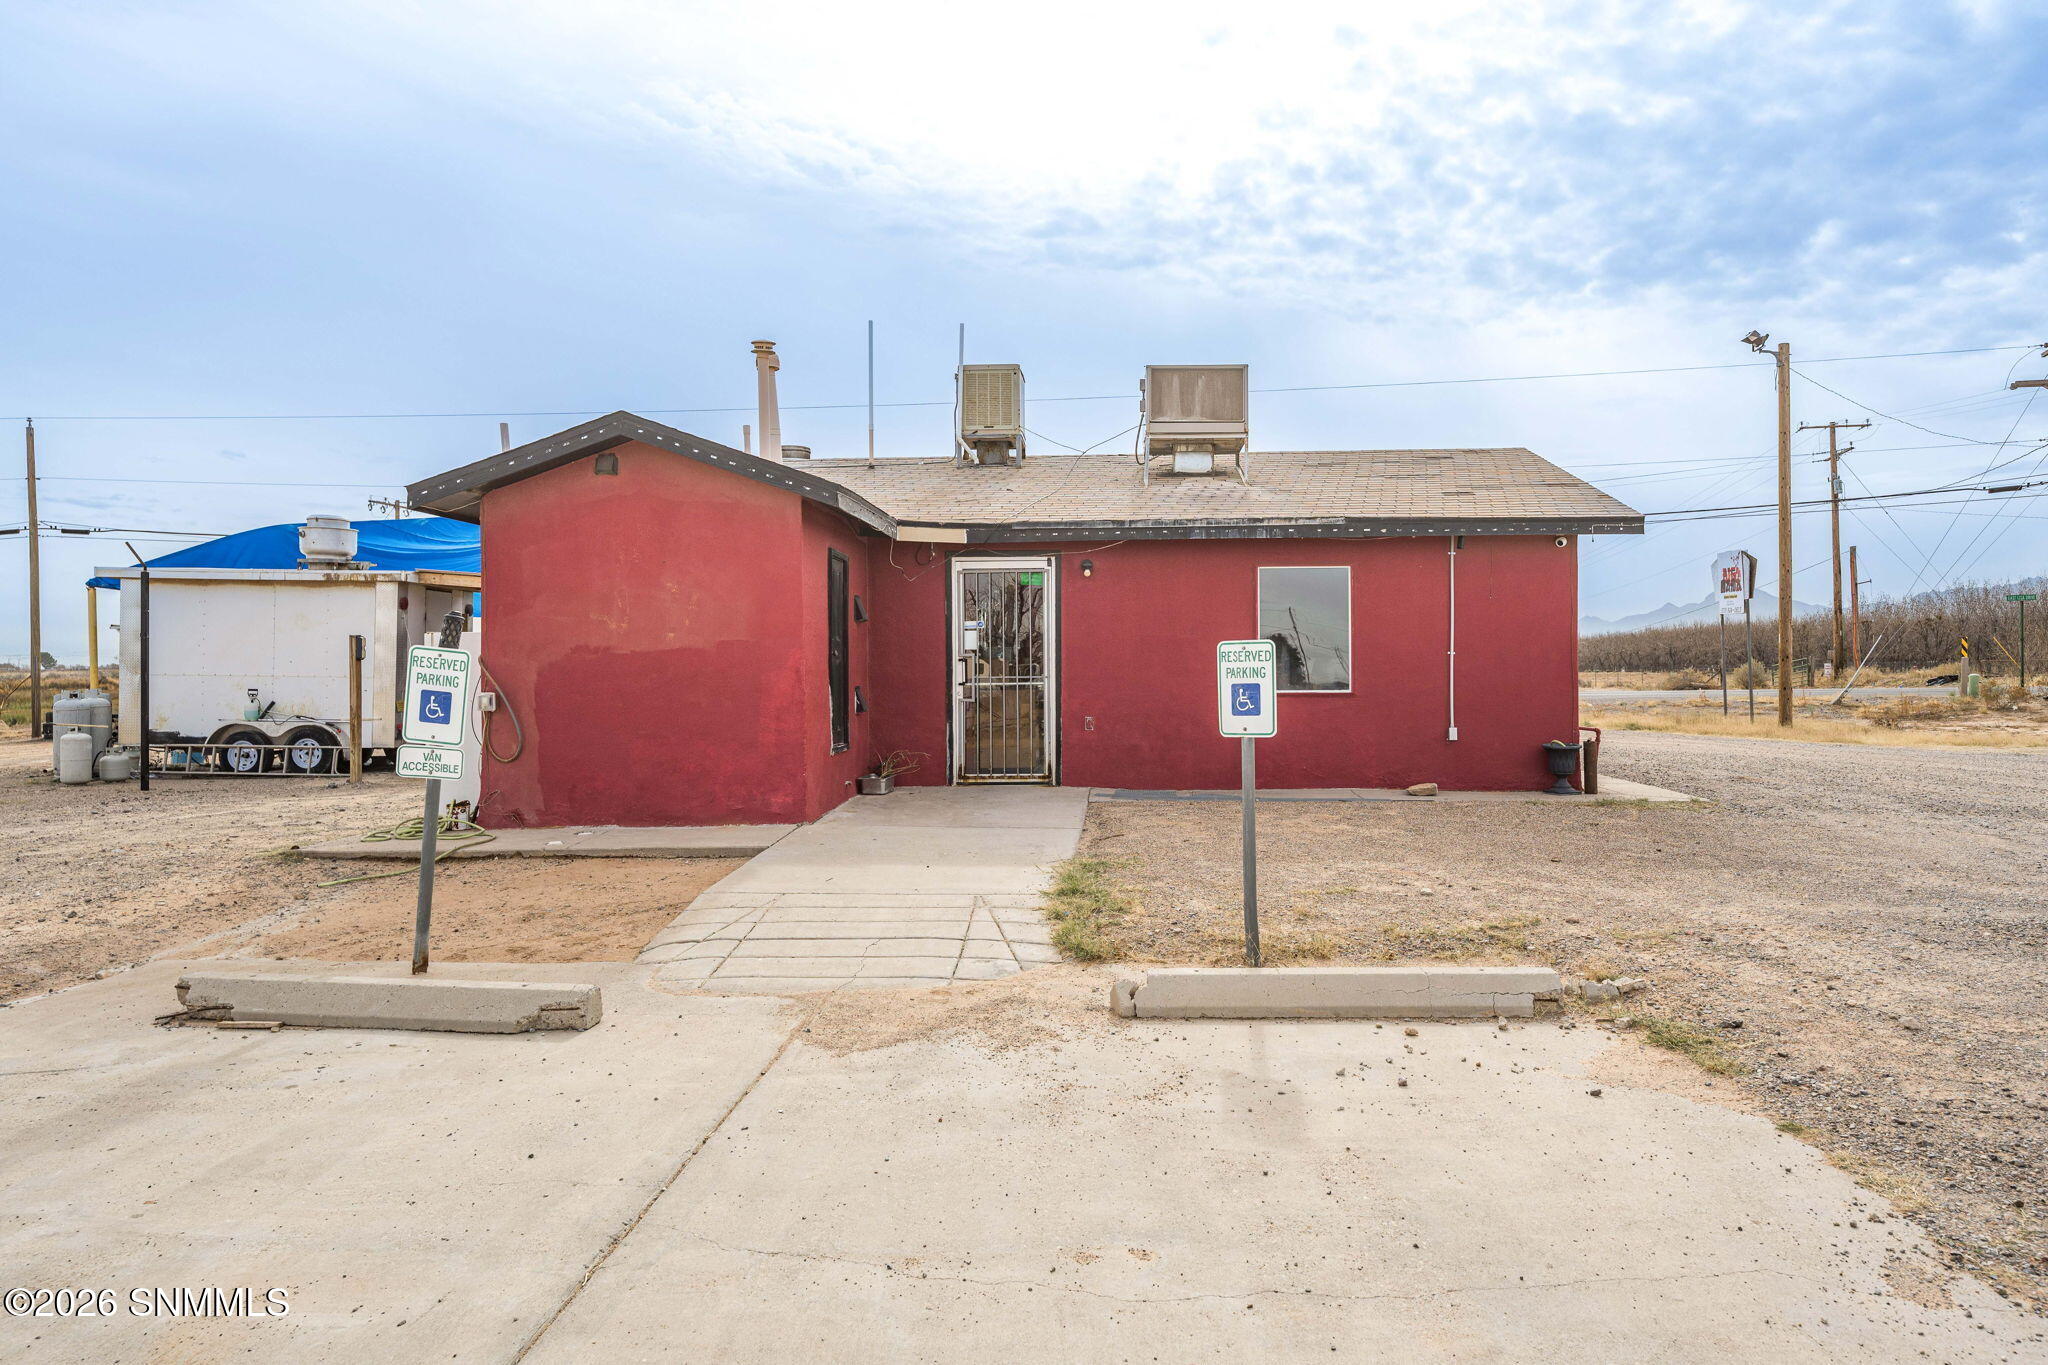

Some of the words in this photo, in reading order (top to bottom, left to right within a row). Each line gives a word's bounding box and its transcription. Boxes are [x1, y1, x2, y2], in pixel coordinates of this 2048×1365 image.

[1221, 650, 1272, 662] RESERVED
[412, 655, 466, 672] RESERVED
[1226, 667, 1266, 679] PARKING
[416, 673, 459, 688] PARKING
[423, 753, 442, 762] VAN
[402, 761, 459, 774] ACCESSIBLE
